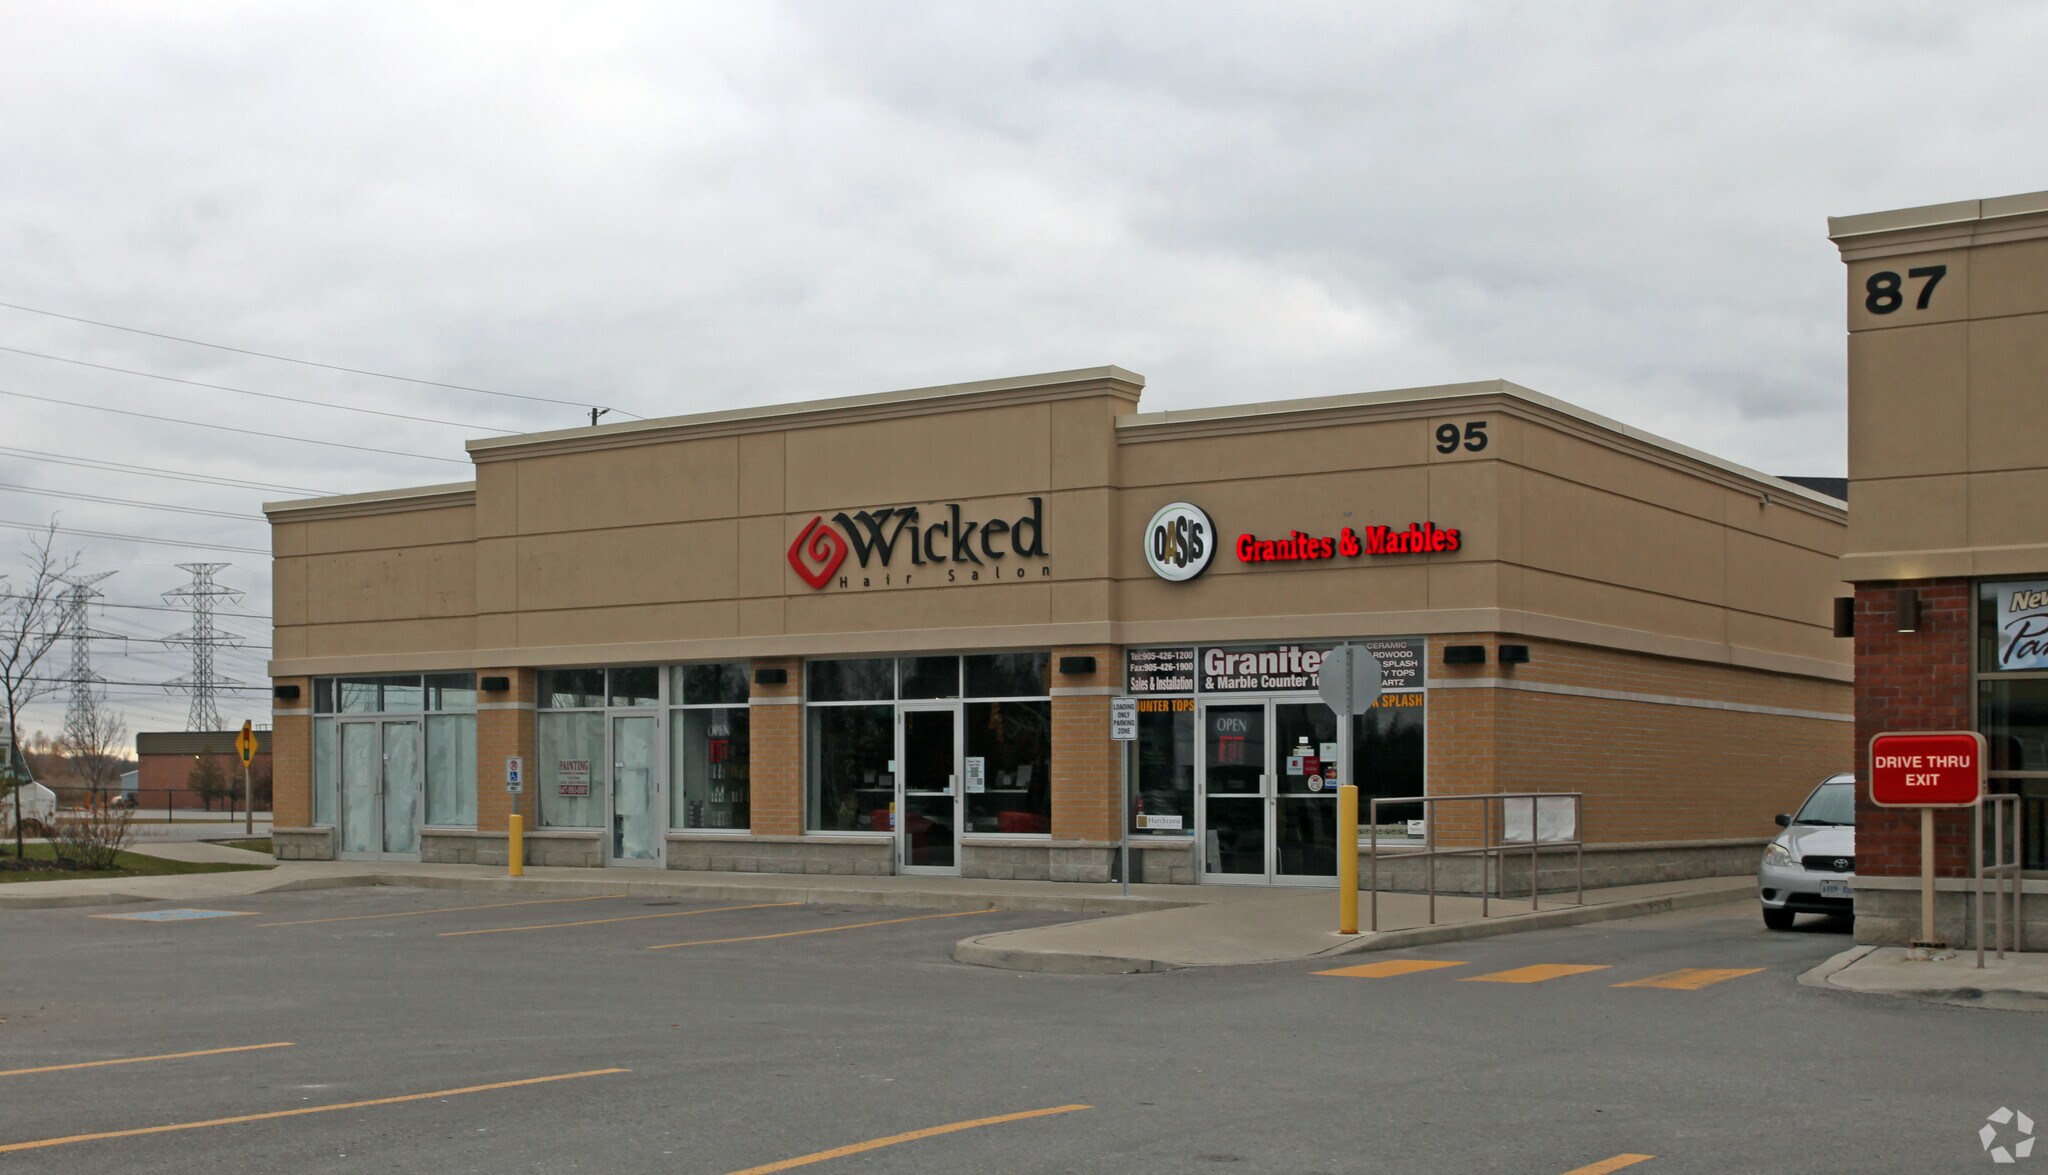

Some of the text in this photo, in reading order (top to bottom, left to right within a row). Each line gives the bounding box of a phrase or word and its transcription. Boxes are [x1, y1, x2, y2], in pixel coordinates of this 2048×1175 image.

[1865, 264, 1947, 315] 87
[1435, 420, 1489, 455] 95
[831, 496, 1049, 569] Wicked
[1153, 514, 1204, 569] OASIS
[1236, 521, 1462, 564] Granites & Marbles
[839, 564, 1050, 589] Hair Salon
[1366, 641, 1408, 650] CERAMIC
[1130, 651, 1194, 661] Tel:905-426-1200
[1372, 650, 1414, 659] RDWOOD
[1129, 662, 1194, 672] Fax:905-426-1900
[1382, 660, 1418, 668] SPLASH
[1391, 669, 1416, 677] TOPS
[1130, 675, 1194, 691] Sales & Installation
[1204, 676, 1215, 690] &
[1217, 675, 1258, 689] Marble
[1261, 674, 1308, 688] Counter
[1381, 679, 1405, 687] ARTZ
[1112, 703, 1135, 711] LOADING
[1171, 699, 1195, 712] TOPS
[1382, 694, 1423, 708] SPLASH
[1117, 711, 1130, 719] ONLY
[1113, 719, 1135, 727] PARKING
[1216, 717, 1247, 732] OPEN
[707, 724, 730, 737] OPEN
[1117, 727, 1131, 735] ZONE
[559, 760, 589, 771] PAINTING
[1875, 755, 1971, 770] DRIVE THRU
[1905, 773, 1941, 787] EXIT
